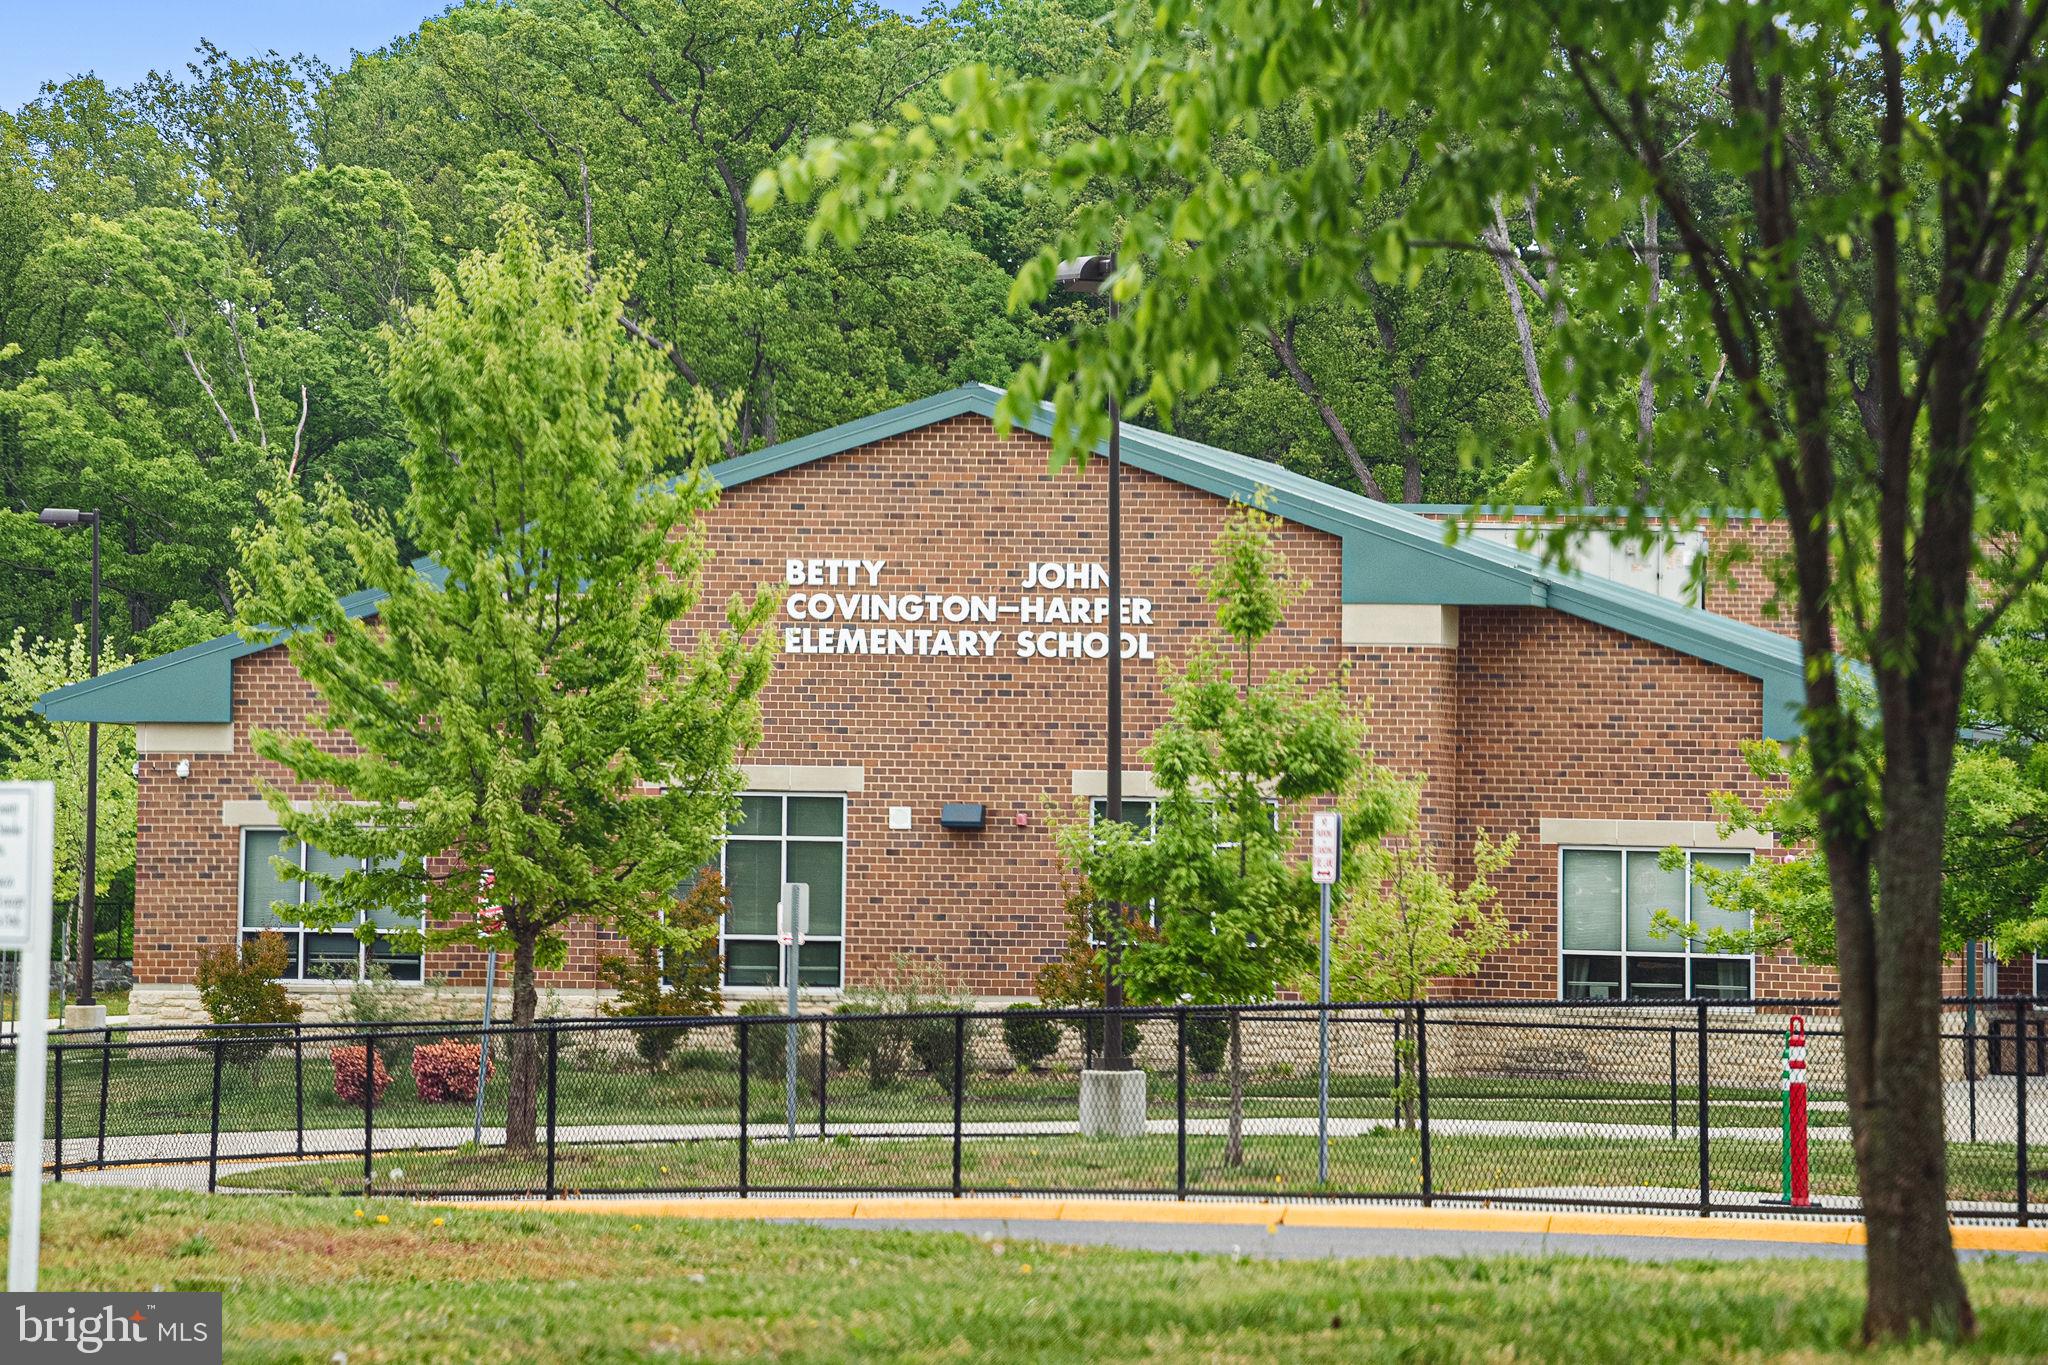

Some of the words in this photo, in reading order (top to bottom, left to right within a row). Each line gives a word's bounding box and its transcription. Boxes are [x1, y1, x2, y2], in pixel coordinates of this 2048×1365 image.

[786, 559, 886, 587] BETTY
[1021, 562, 1110, 590] JOHN
[785, 627, 1001, 657] ELEMENTARY
[1017, 631, 1155, 660] SCHOOL
